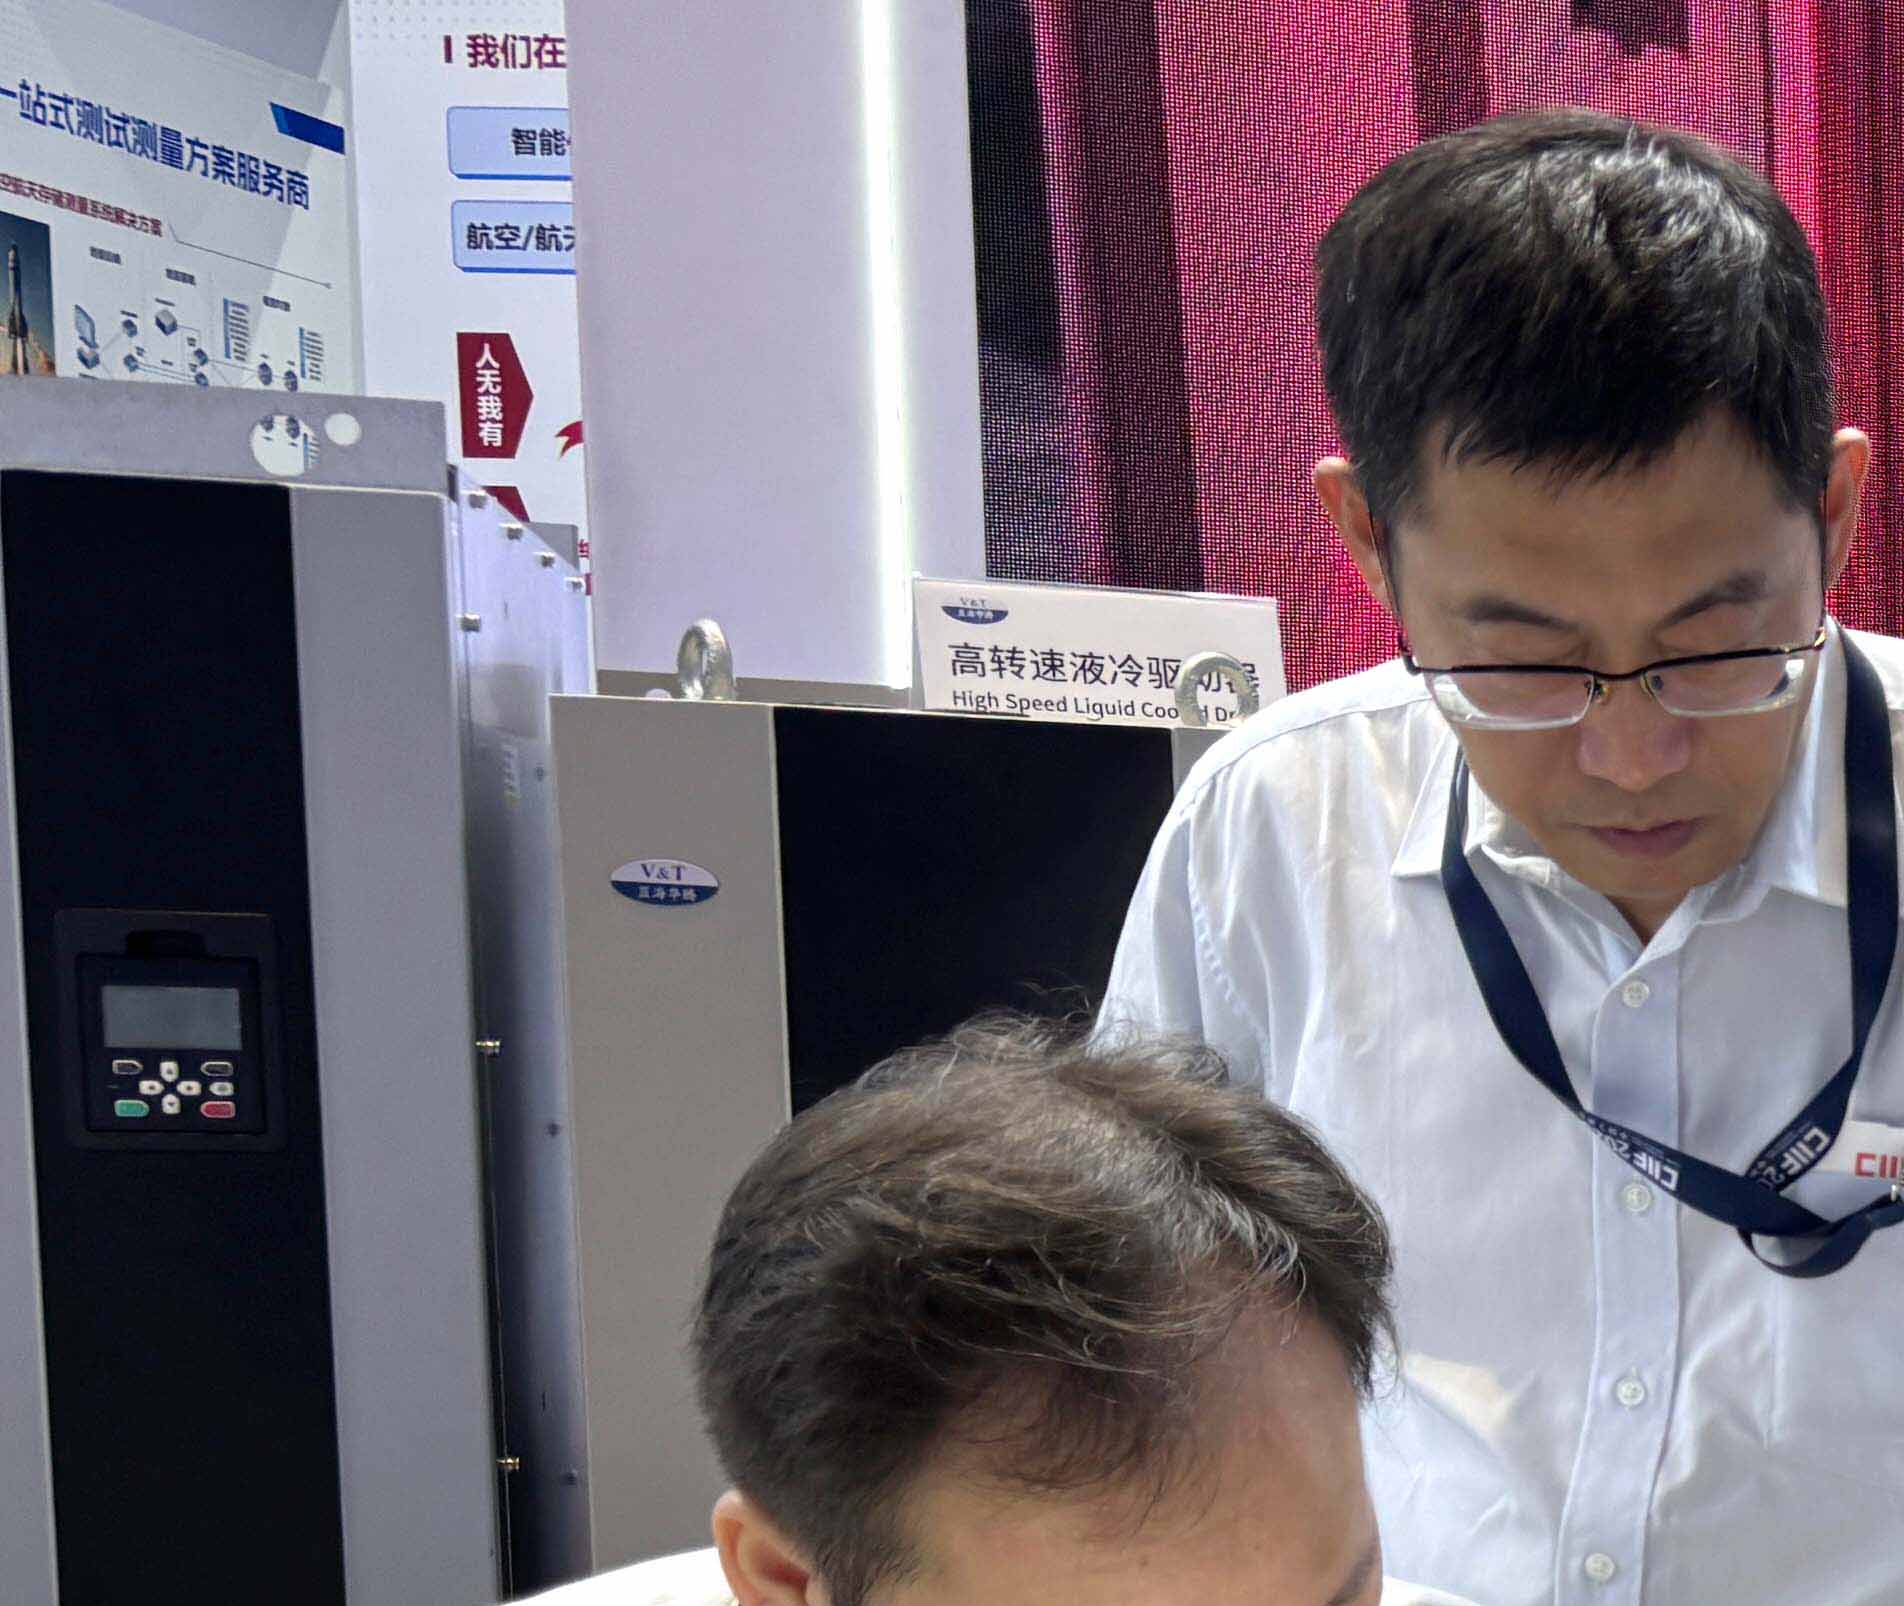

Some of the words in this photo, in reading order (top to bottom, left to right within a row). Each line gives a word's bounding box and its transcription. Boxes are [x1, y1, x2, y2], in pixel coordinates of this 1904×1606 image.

[467, 33, 567, 69] 我们在
[0, 78, 310, 210] 一站式测试测量方案服务商
[511, 128, 571, 156] 智能
[476, 343, 504, 447] 人无我有
[953, 690, 999, 711] High
[1006, 694, 1068, 716] Speed
[1075, 697, 1136, 718] Liquid
[1141, 702, 1208, 722] Coo
[640, 863, 687, 881] V&T
